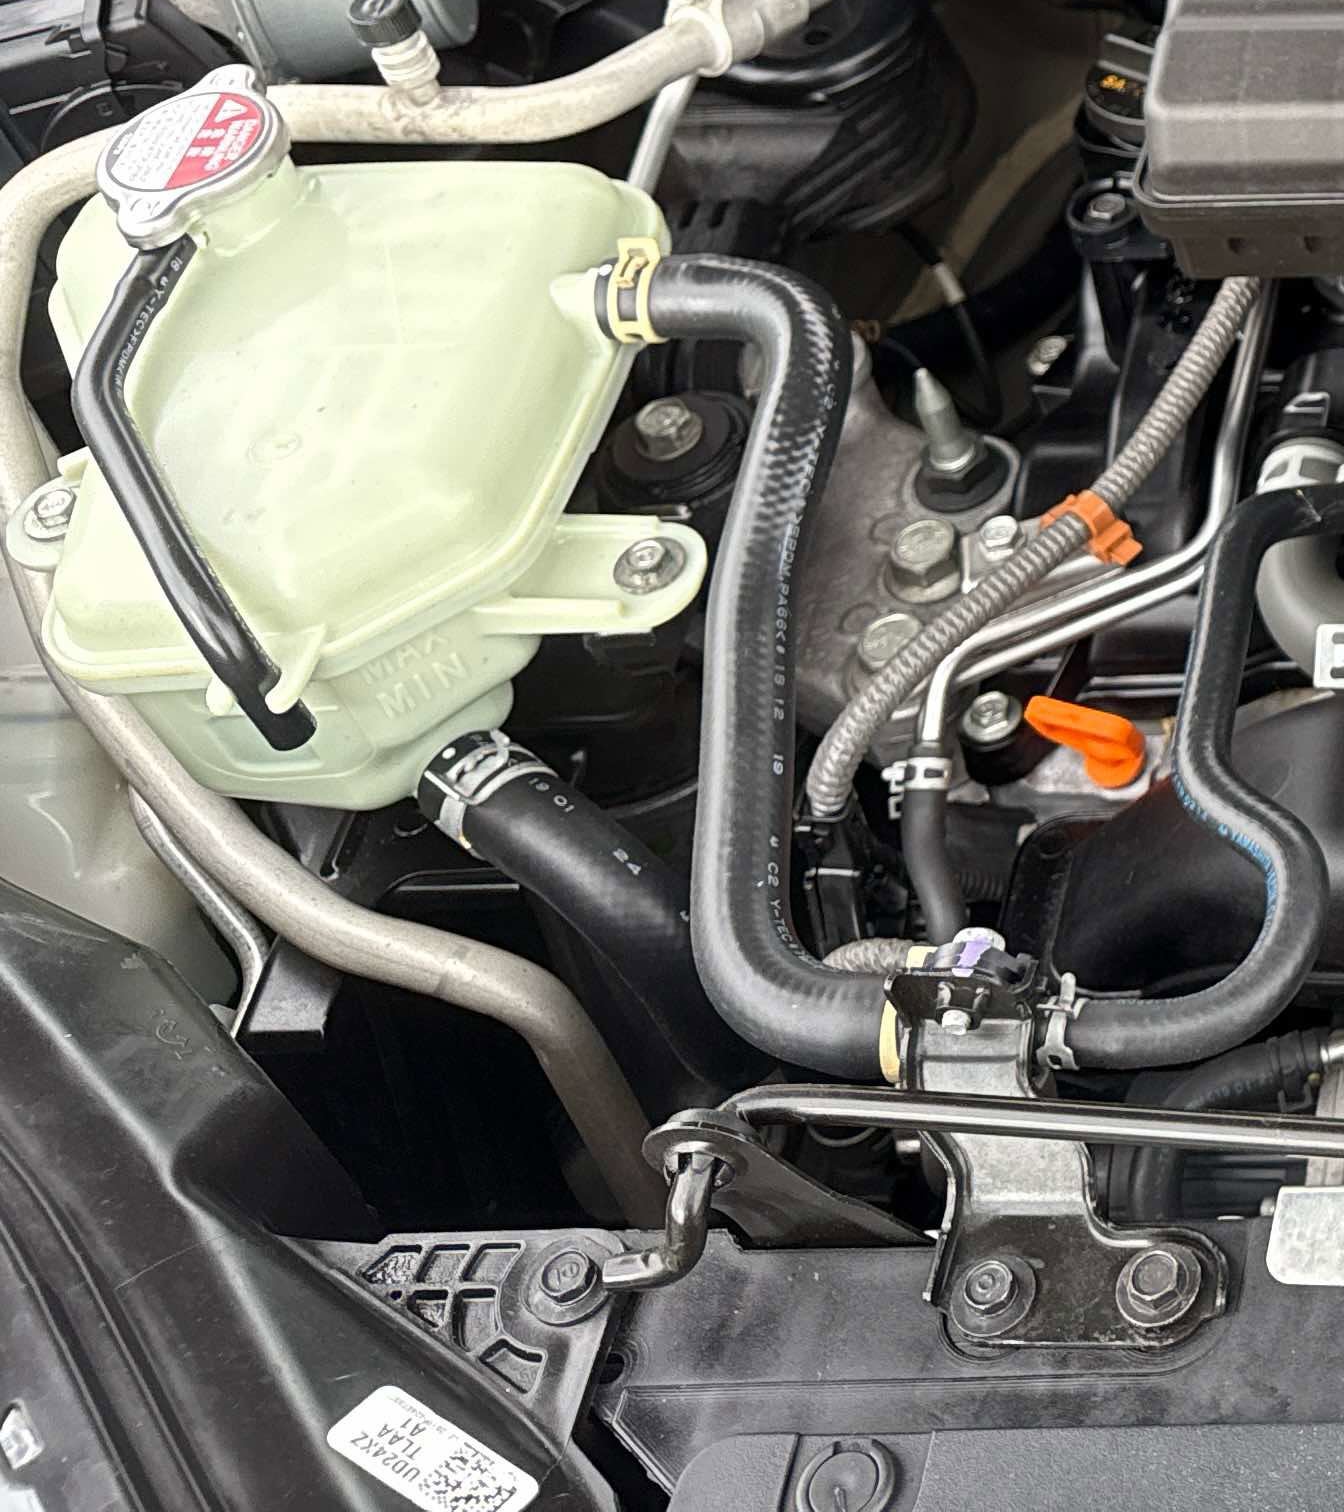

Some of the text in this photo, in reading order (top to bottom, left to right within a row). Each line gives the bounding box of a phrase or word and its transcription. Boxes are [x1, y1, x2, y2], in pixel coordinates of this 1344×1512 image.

[376, 652, 469, 719] MIN
[771, 752, 785, 776] 19
[377, 1423, 422, 1460] TLAA
